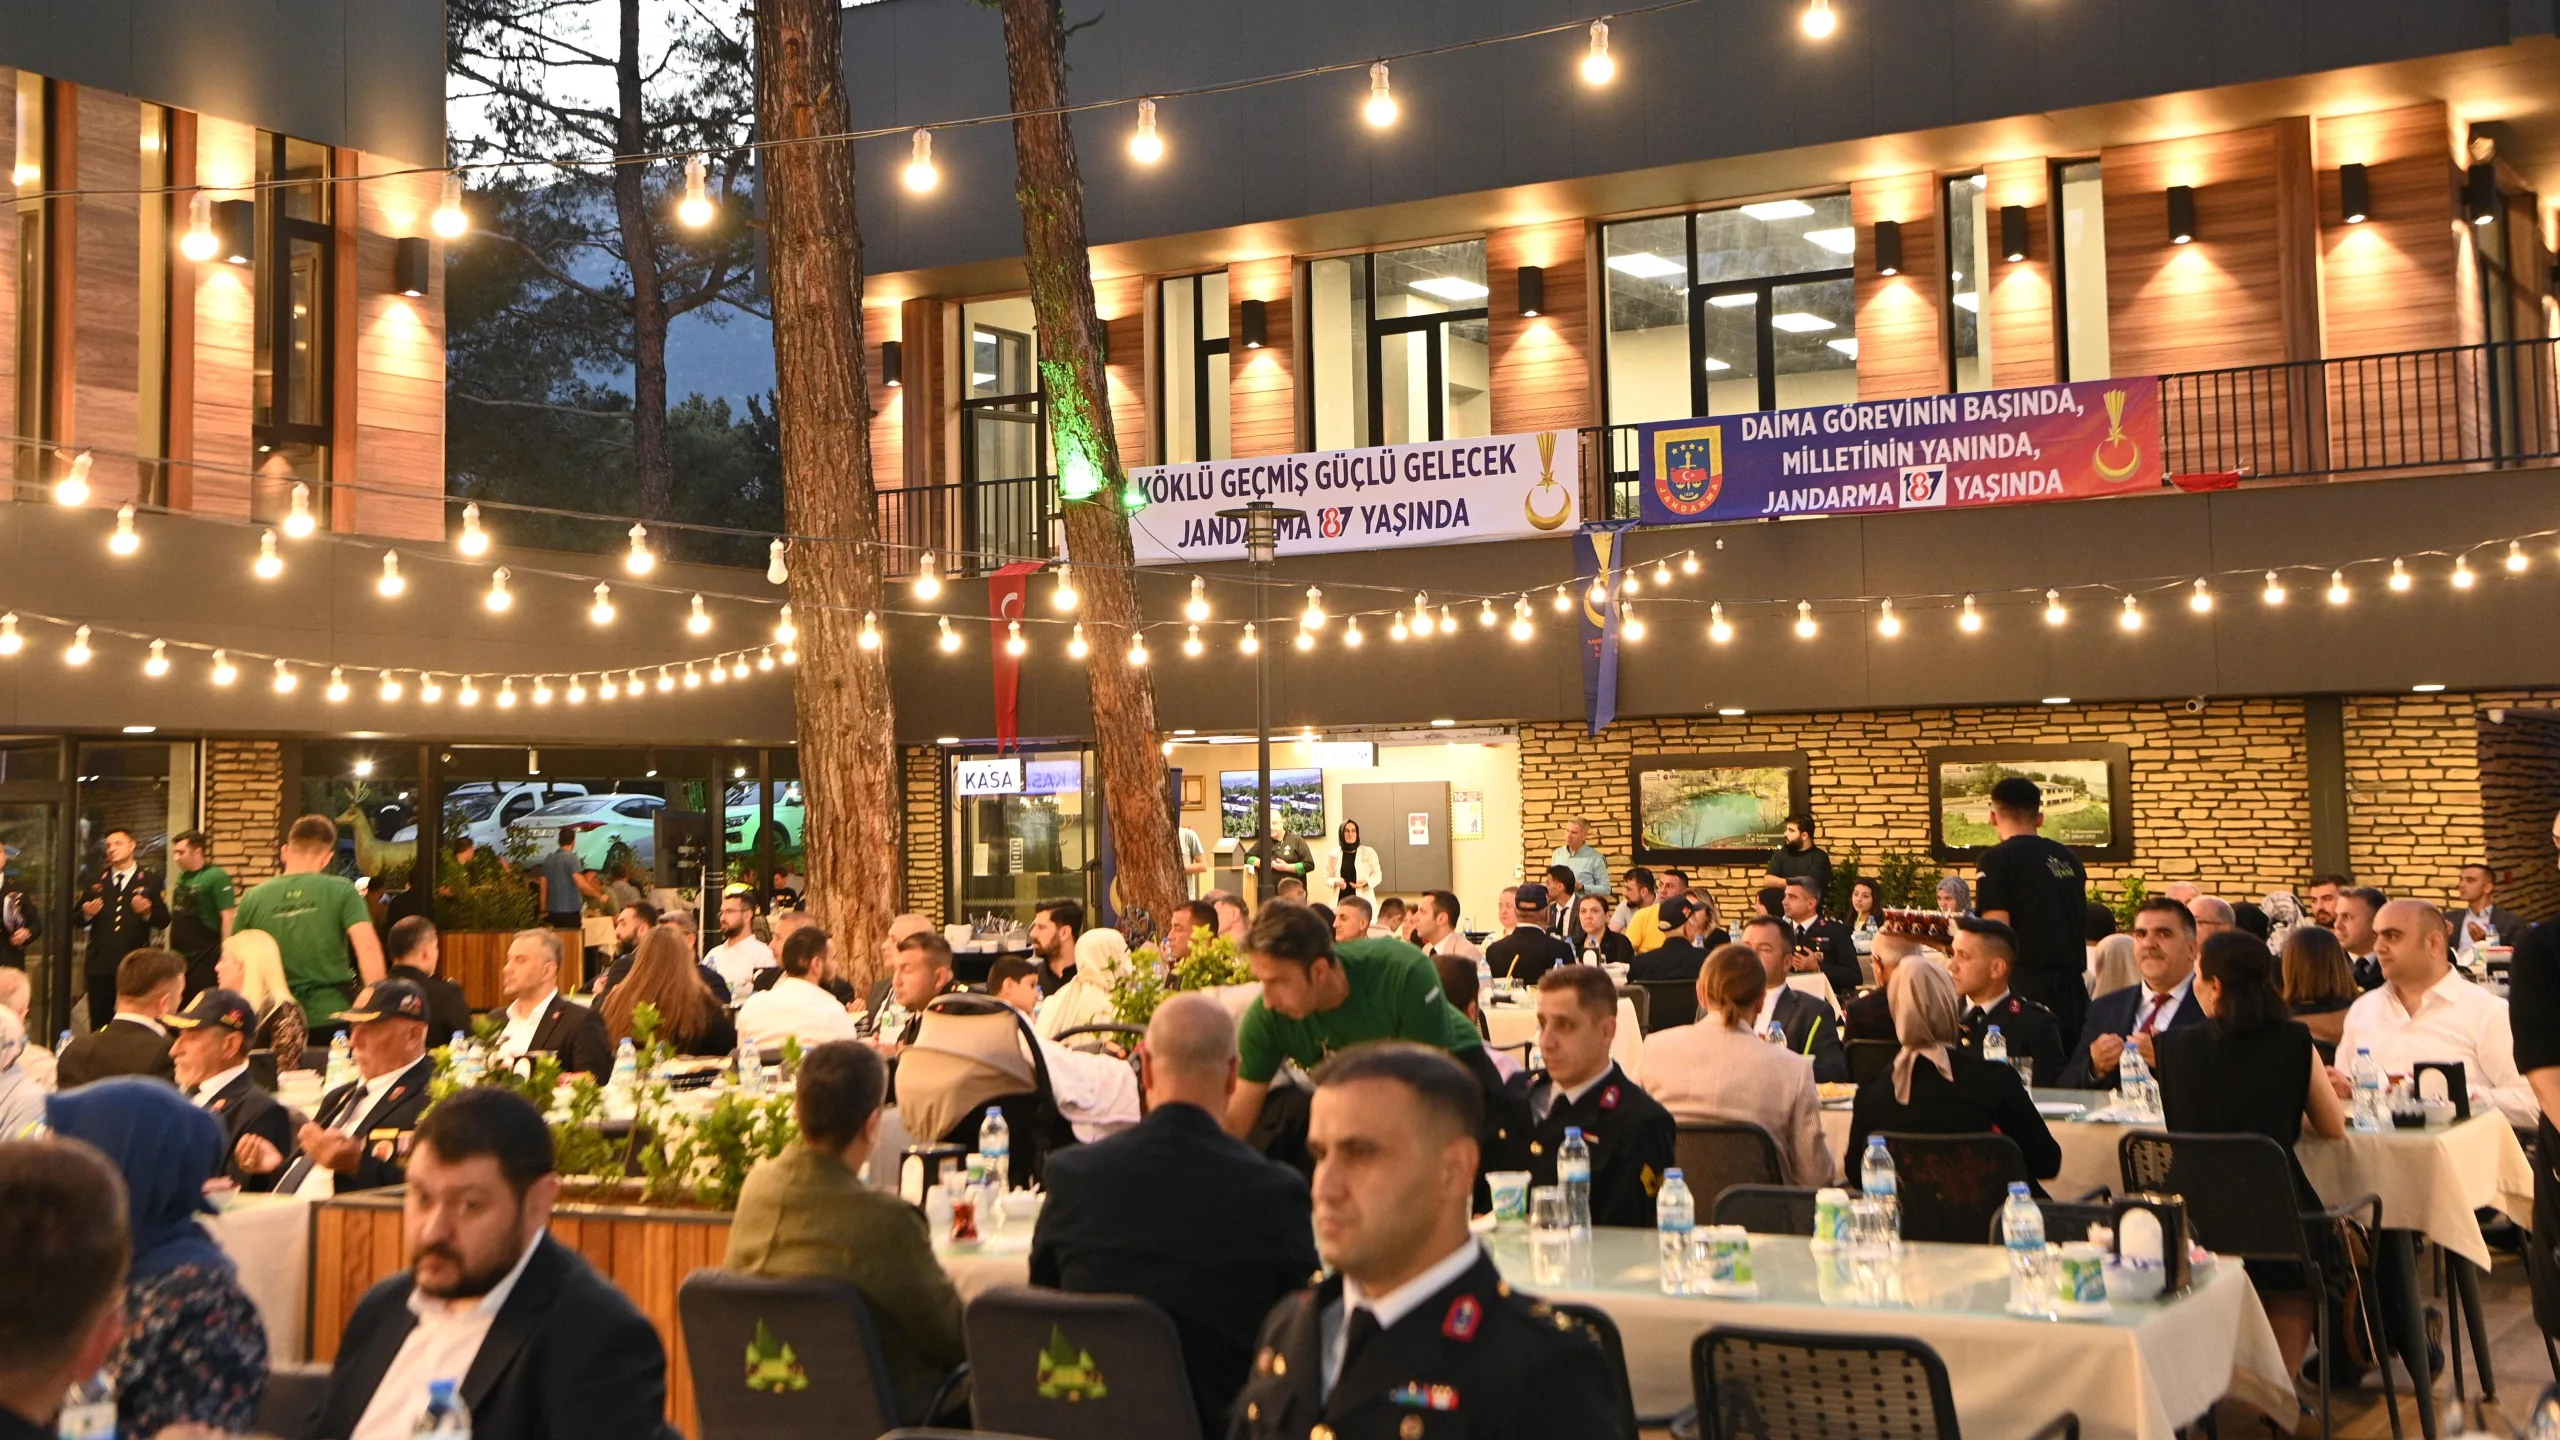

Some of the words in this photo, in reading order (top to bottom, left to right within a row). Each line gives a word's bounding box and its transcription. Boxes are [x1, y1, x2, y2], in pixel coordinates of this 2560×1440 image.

[1741, 411, 1817, 441] DAİMA
[1823, 395, 1956, 434] GÖREVİNİN
[1964, 387, 2084, 423] BAŞINDA,
[1138, 465, 1213, 504] KÖKLÜ
[1221, 457, 1308, 500] GEÇMİŞ
[1315, 448, 1396, 492] GÜÇLÜ
[1404, 443, 1516, 483] GELECEK
[1783, 437, 1914, 476] MİLLETİNİN
[1920, 431, 2041, 464] YANINDA,
[1659, 483, 1719, 513] JANDARMA
[1761, 482, 1894, 514] JANDARMA
[1903, 470, 1944, 502] 187
[1954, 468, 2064, 503] YAŞINDA
[1178, 511, 1312, 548] JANDMA
[1317, 505, 1354, 539] 187
[1360, 498, 1470, 537] YAŞINDA
[965, 771, 1013, 789] KASA
